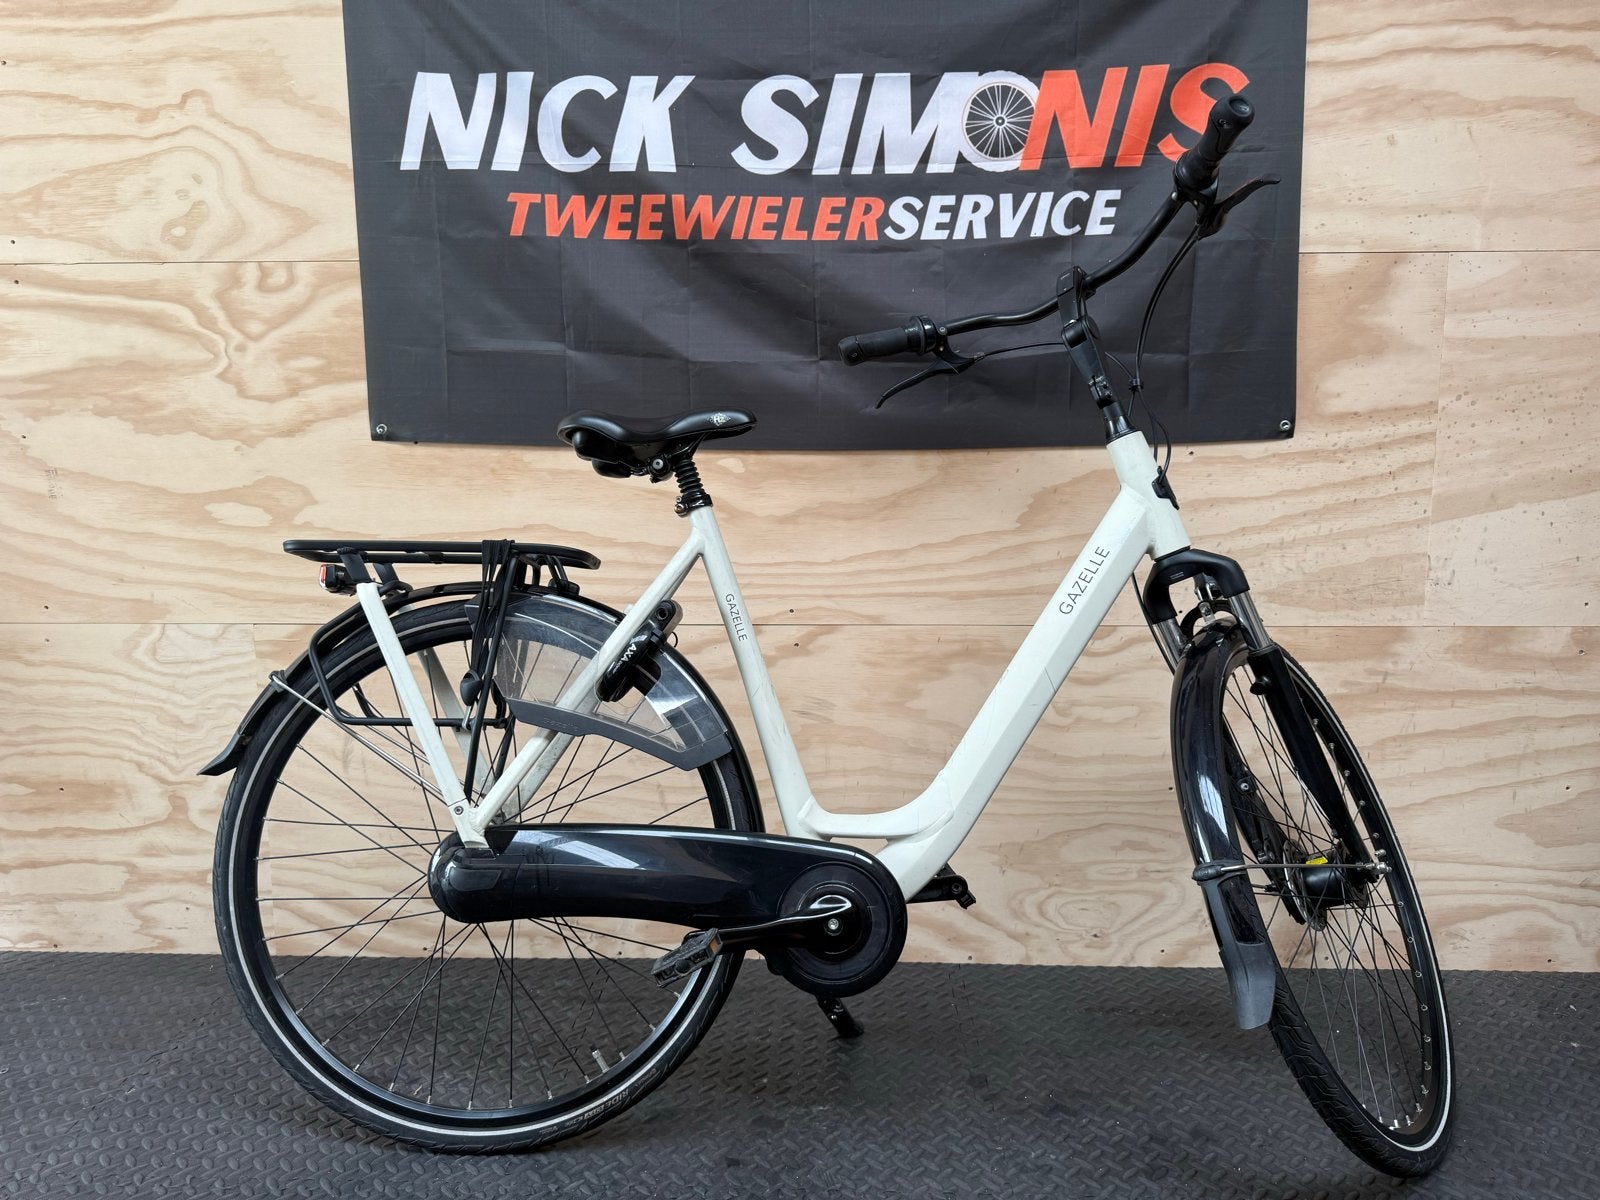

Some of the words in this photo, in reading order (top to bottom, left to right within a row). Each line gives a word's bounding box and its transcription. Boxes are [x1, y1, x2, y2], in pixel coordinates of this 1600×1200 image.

[400, 71, 696, 173] NICK
[506, 189, 1122, 242] TWEEWIELERSERVICE
[1058, 546, 1110, 615] GAZELLE
[725, 593, 748, 643] GAZELLE
[620, 643, 637, 662] AXA
